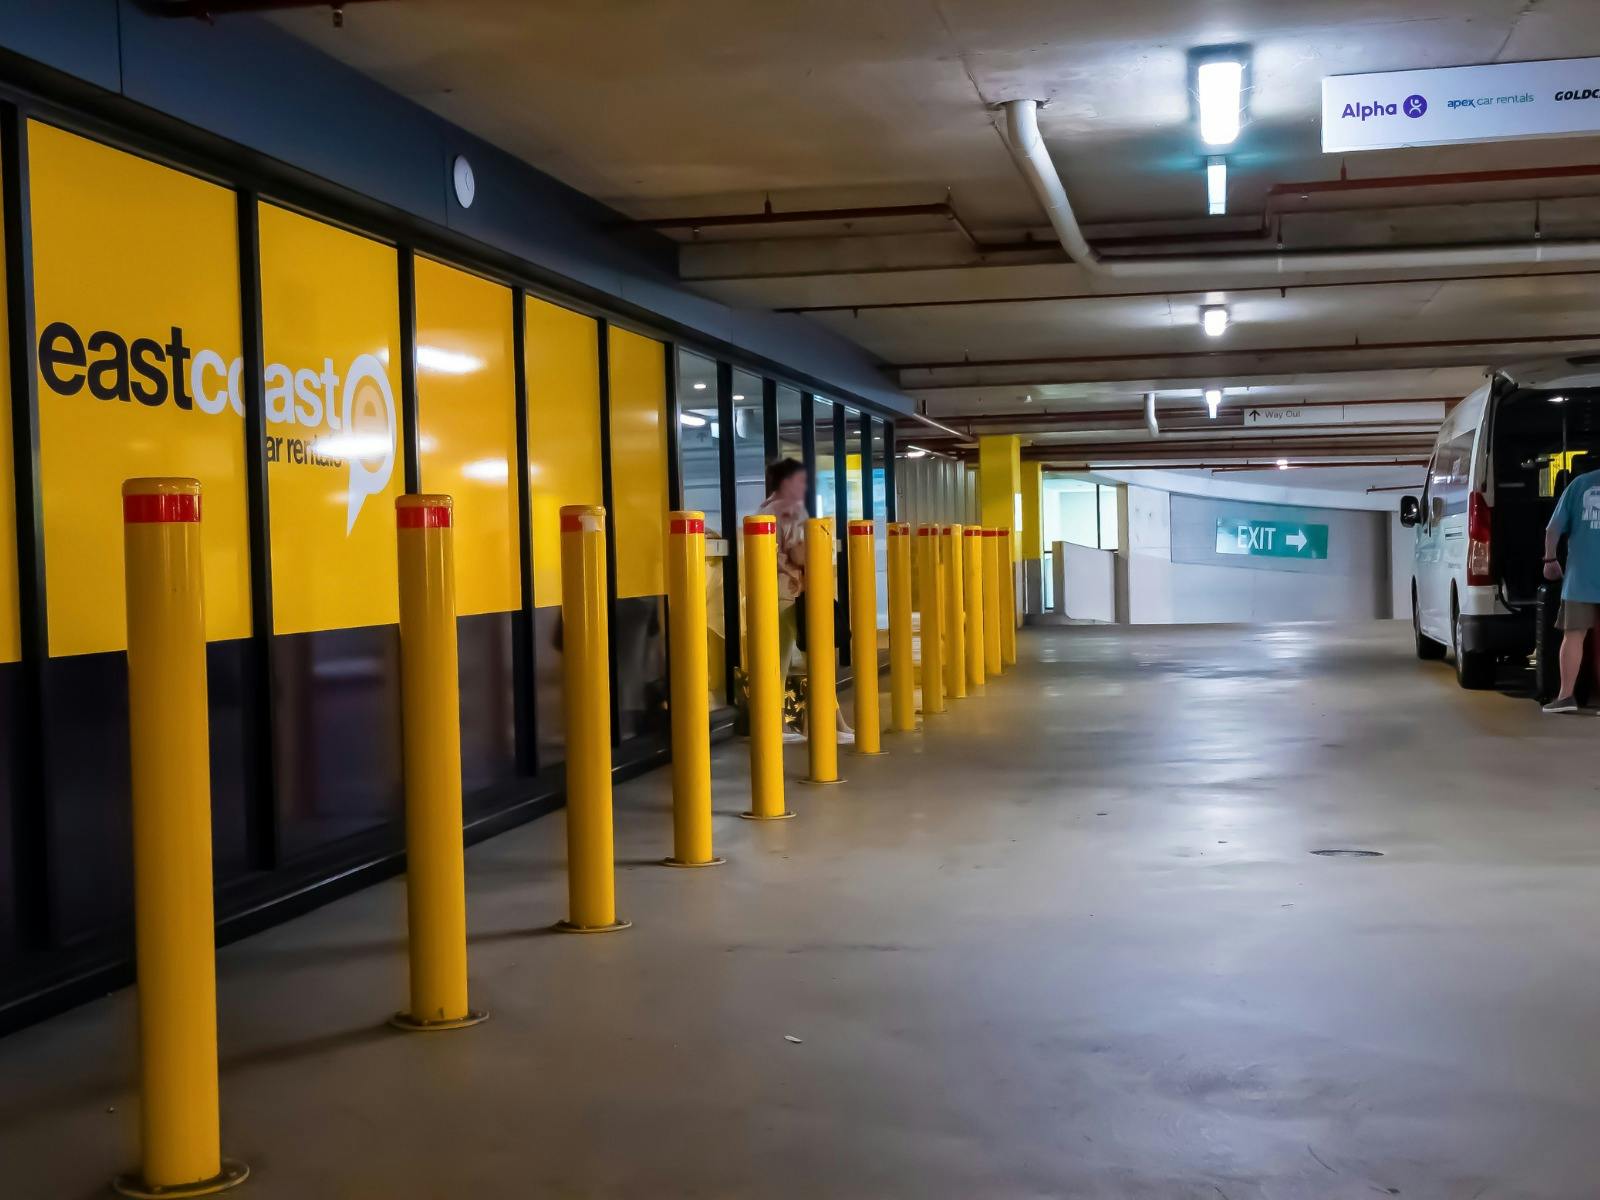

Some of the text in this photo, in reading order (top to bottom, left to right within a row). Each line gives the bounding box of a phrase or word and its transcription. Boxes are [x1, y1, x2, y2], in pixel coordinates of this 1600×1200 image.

[1447, 92, 1535, 109] apex car rentals
[1554, 88, 1600, 101] GOLDC
[1341, 101, 1397, 121] Alpha
[1264, 410, 1284, 420] Way
[265, 436, 283, 462] ar
[1237, 525, 1277, 550] EXIT
